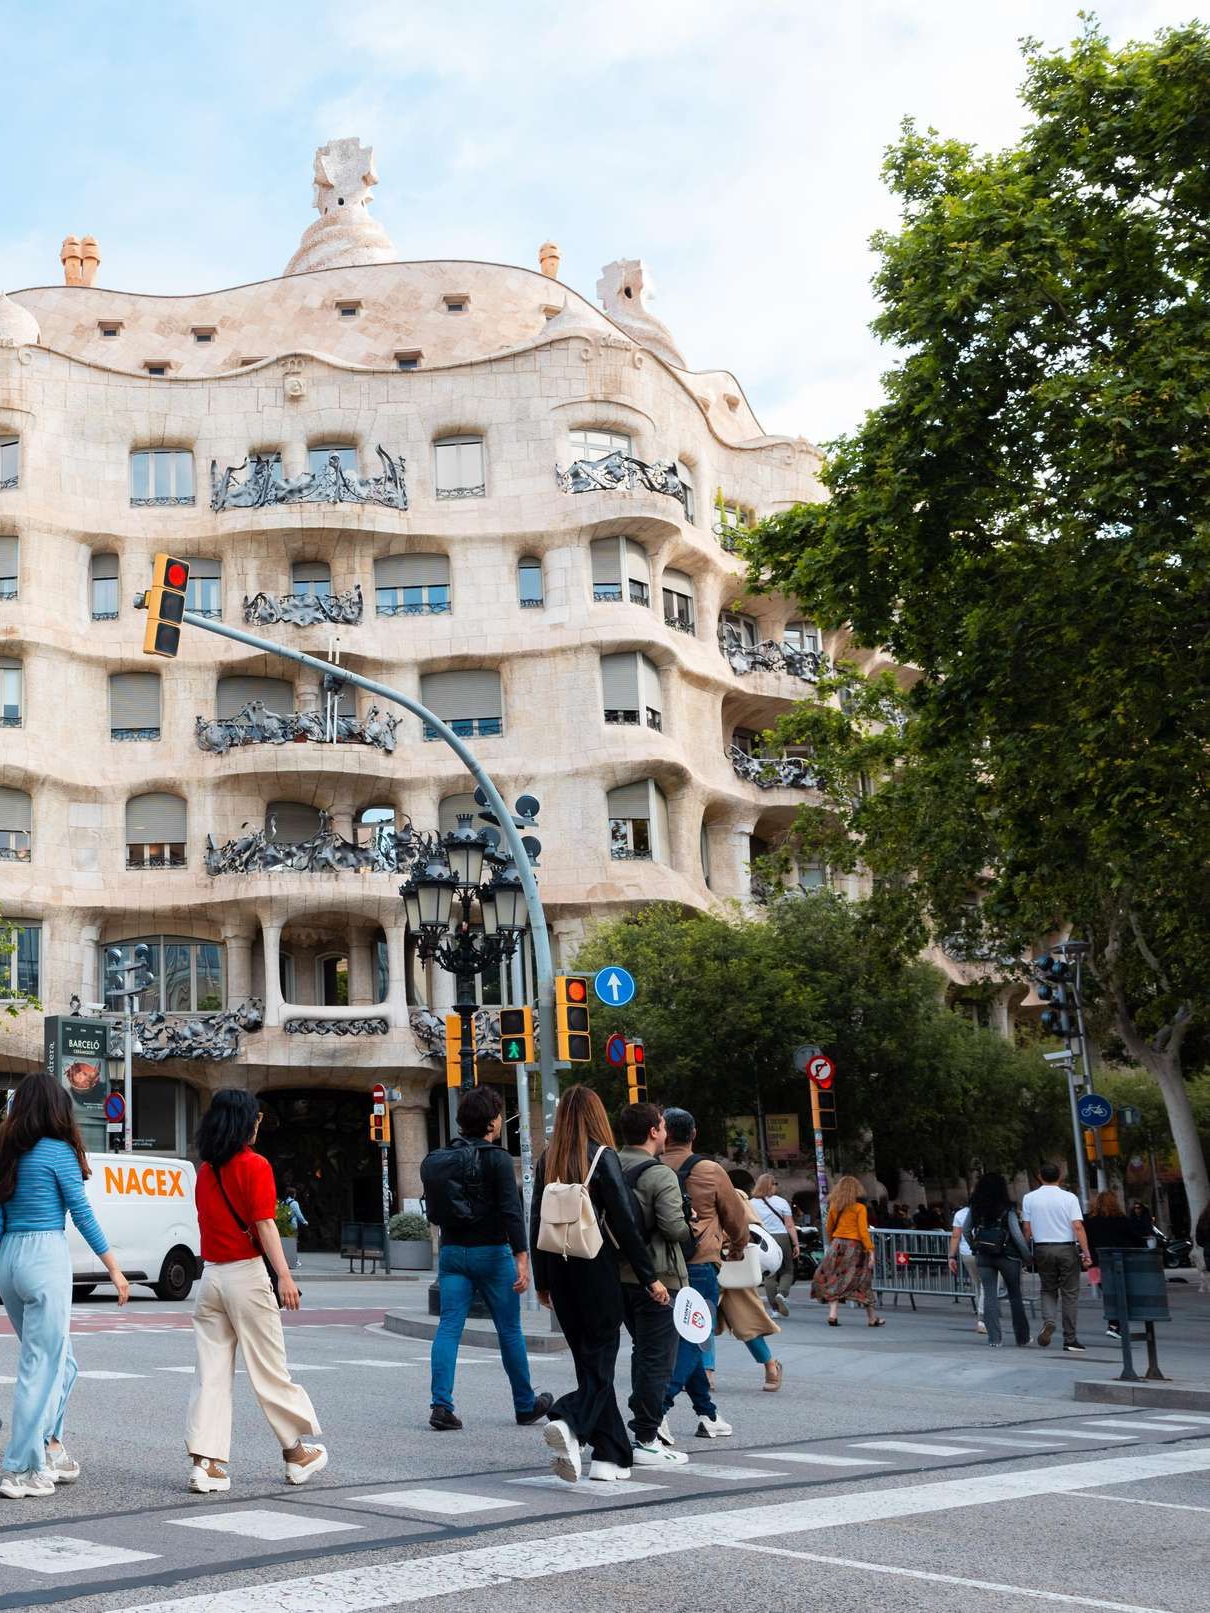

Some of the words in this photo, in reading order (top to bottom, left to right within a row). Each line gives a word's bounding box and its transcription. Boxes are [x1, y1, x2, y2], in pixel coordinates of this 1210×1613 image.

[46, 1041, 55, 1073] drera
[68, 1039, 100, 1050] BARCELÓ
[104, 1166, 184, 1197] NACEX
